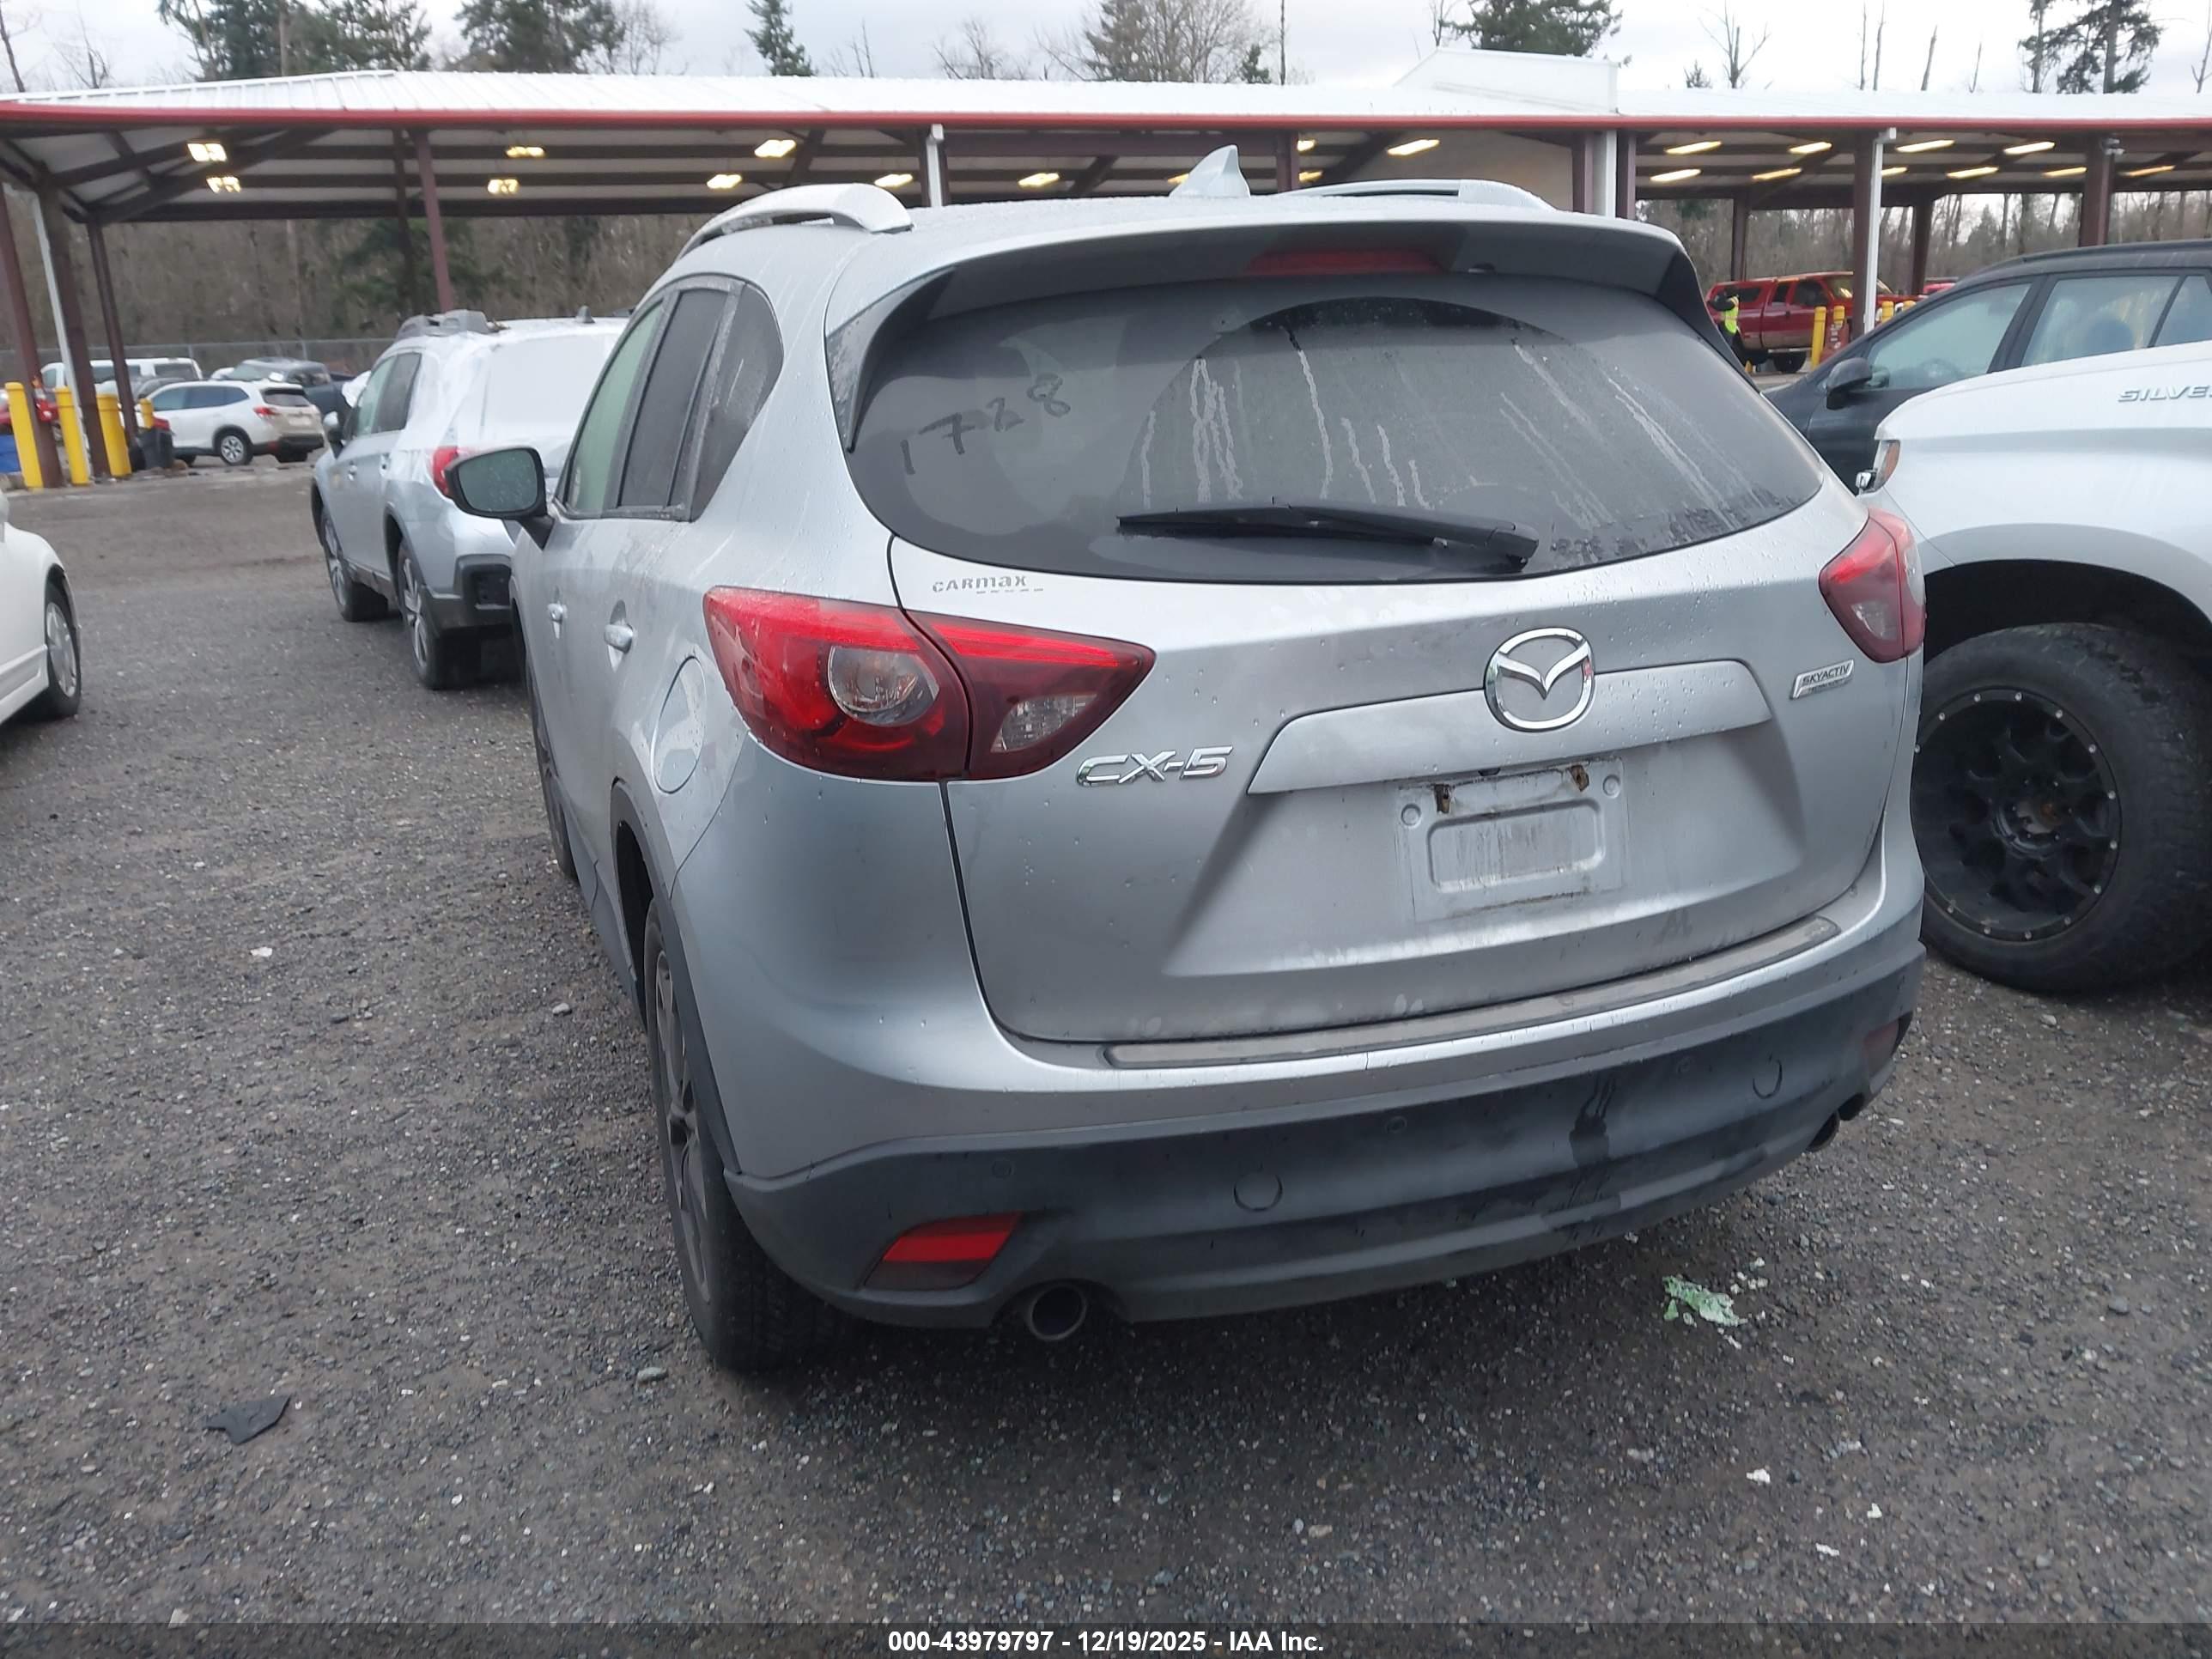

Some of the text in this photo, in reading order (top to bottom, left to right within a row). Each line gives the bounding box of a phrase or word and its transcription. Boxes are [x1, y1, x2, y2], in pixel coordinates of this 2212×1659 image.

[2118, 385, 2212, 404] SILVE
[1802, 662, 1850, 686] SKYACTIV
[1076, 744, 1234, 787] CX-5
